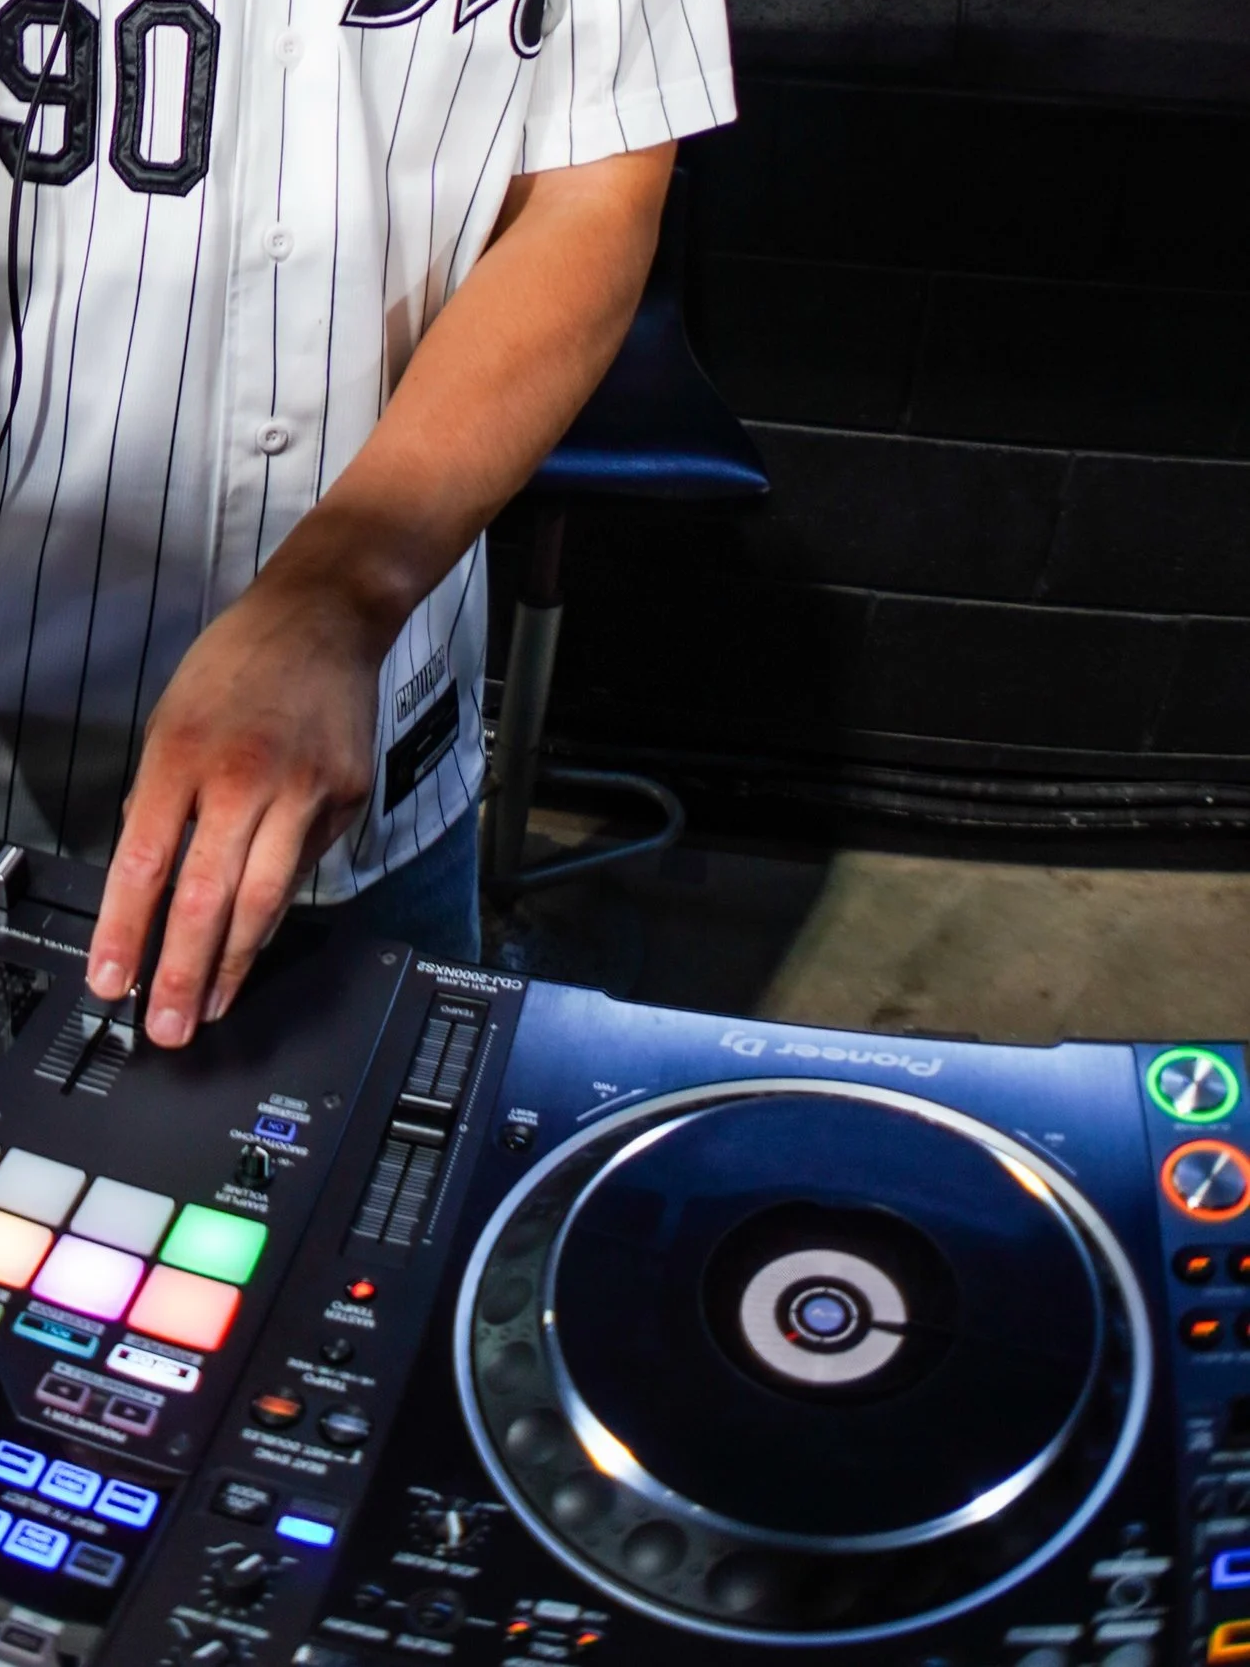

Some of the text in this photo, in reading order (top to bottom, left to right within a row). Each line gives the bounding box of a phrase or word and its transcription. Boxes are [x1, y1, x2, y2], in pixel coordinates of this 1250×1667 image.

[415, 959, 523, 990] CDJ-2000NXS2
[439, 1003, 475, 1018] TEMPO
[773, 1041, 943, 1077] Pioneer
